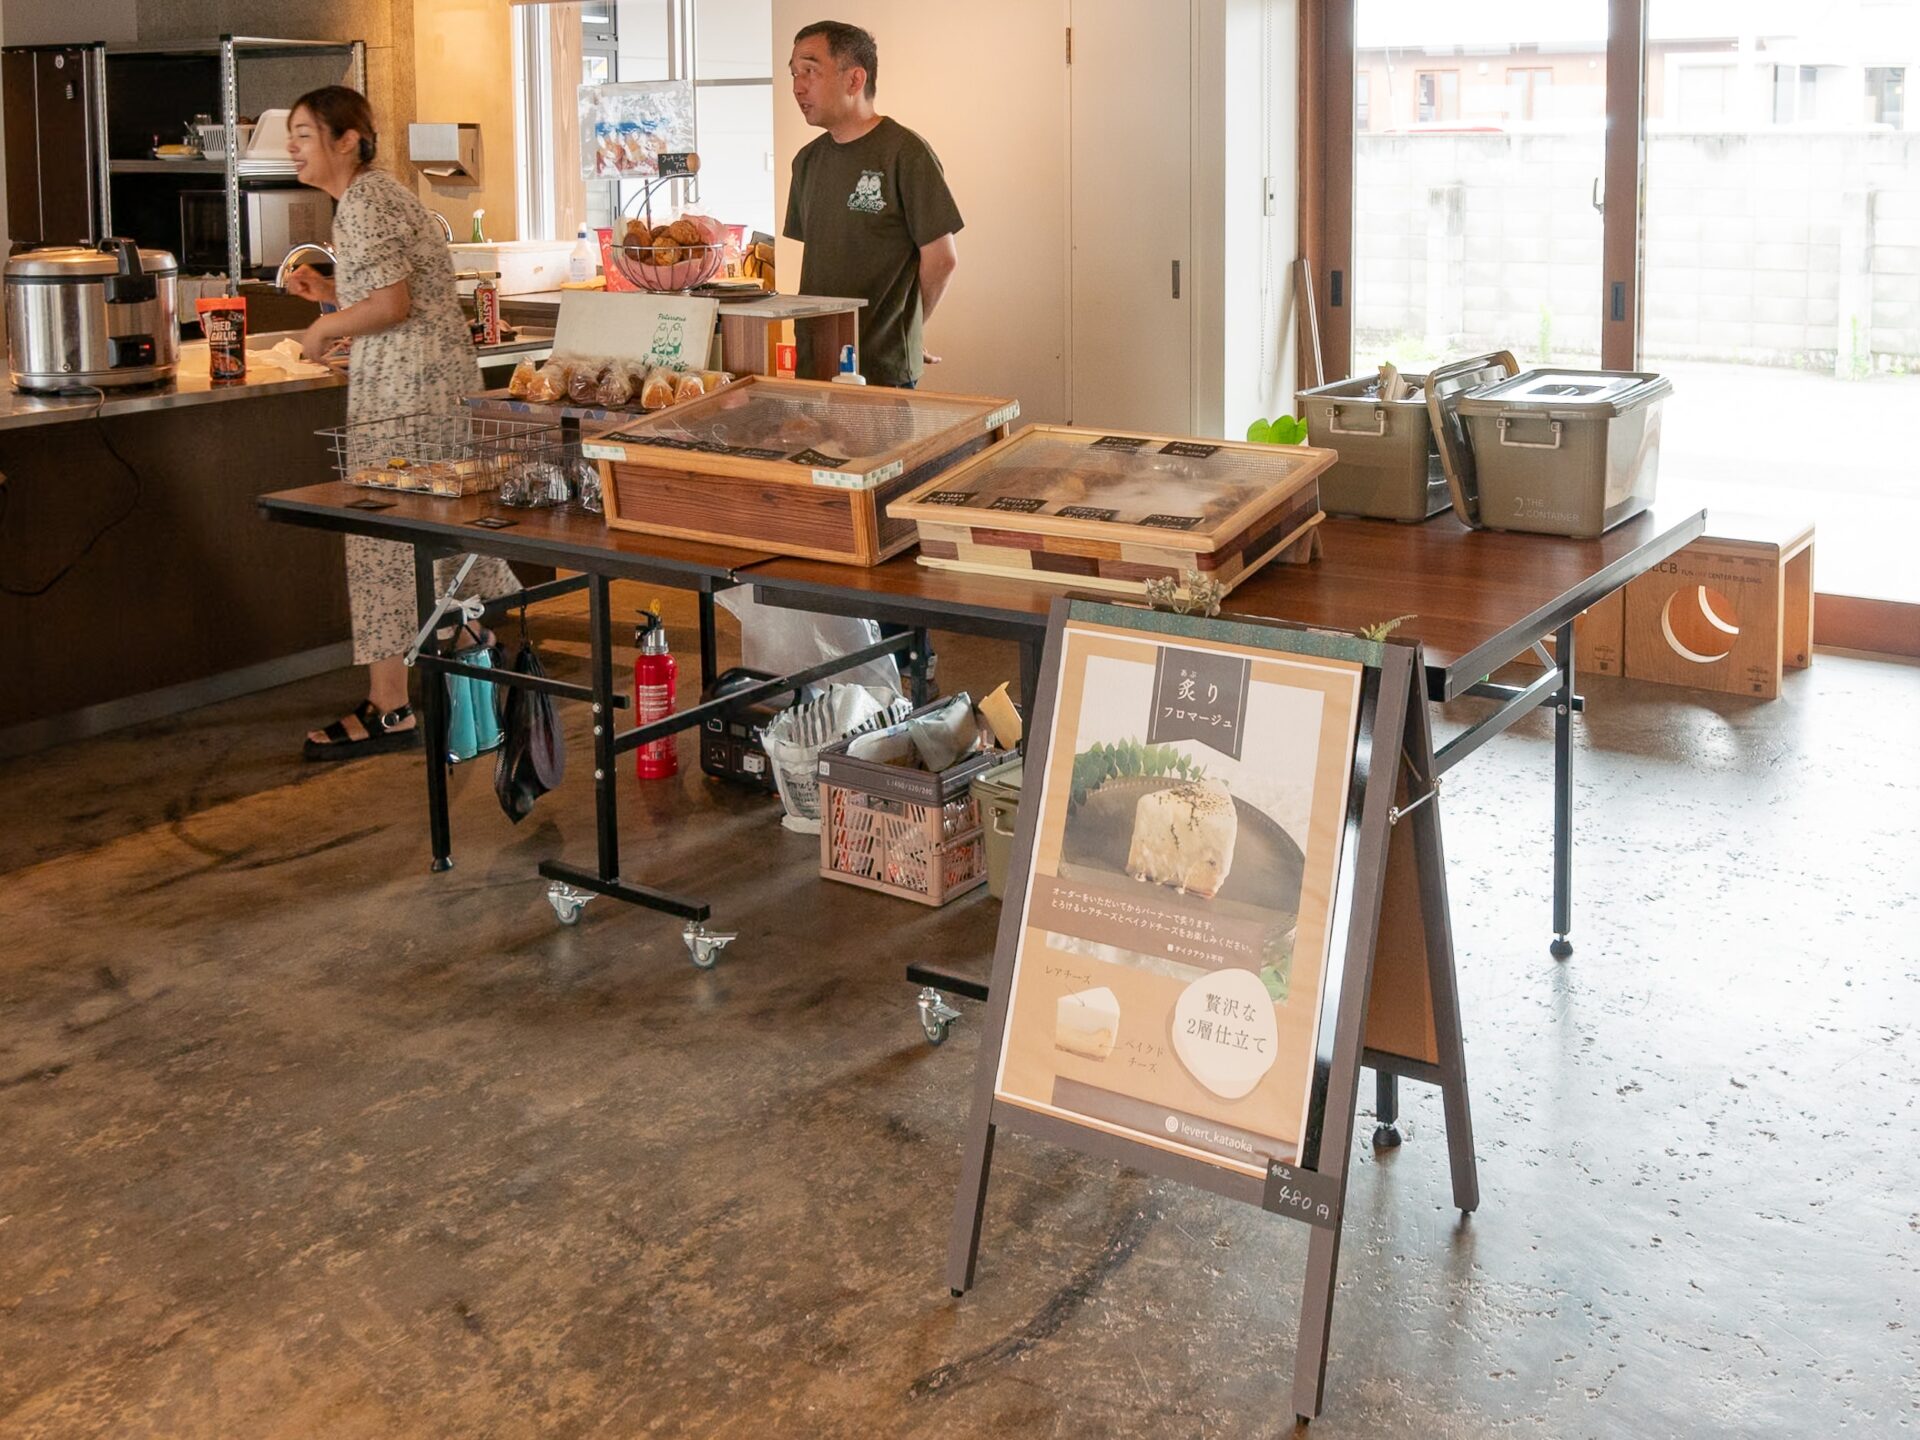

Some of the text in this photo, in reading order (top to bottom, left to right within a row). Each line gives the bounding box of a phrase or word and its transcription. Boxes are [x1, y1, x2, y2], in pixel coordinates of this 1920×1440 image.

[1526, 498, 1545, 508] THE
[1526, 510, 1580, 521] CONTAINER
[1177, 679, 1218, 704] 炙り
[1164, 706, 1232, 728] フロマージュ
[1045, 965, 1092, 985] レアチーズ
[1204, 992, 1256, 1022] 贅沢な
[1186, 1018, 1267, 1054] 2層仕立て
[1128, 1057, 1158, 1073] チーズ
[1181, 1121, 1253, 1153] levert_kataoka
